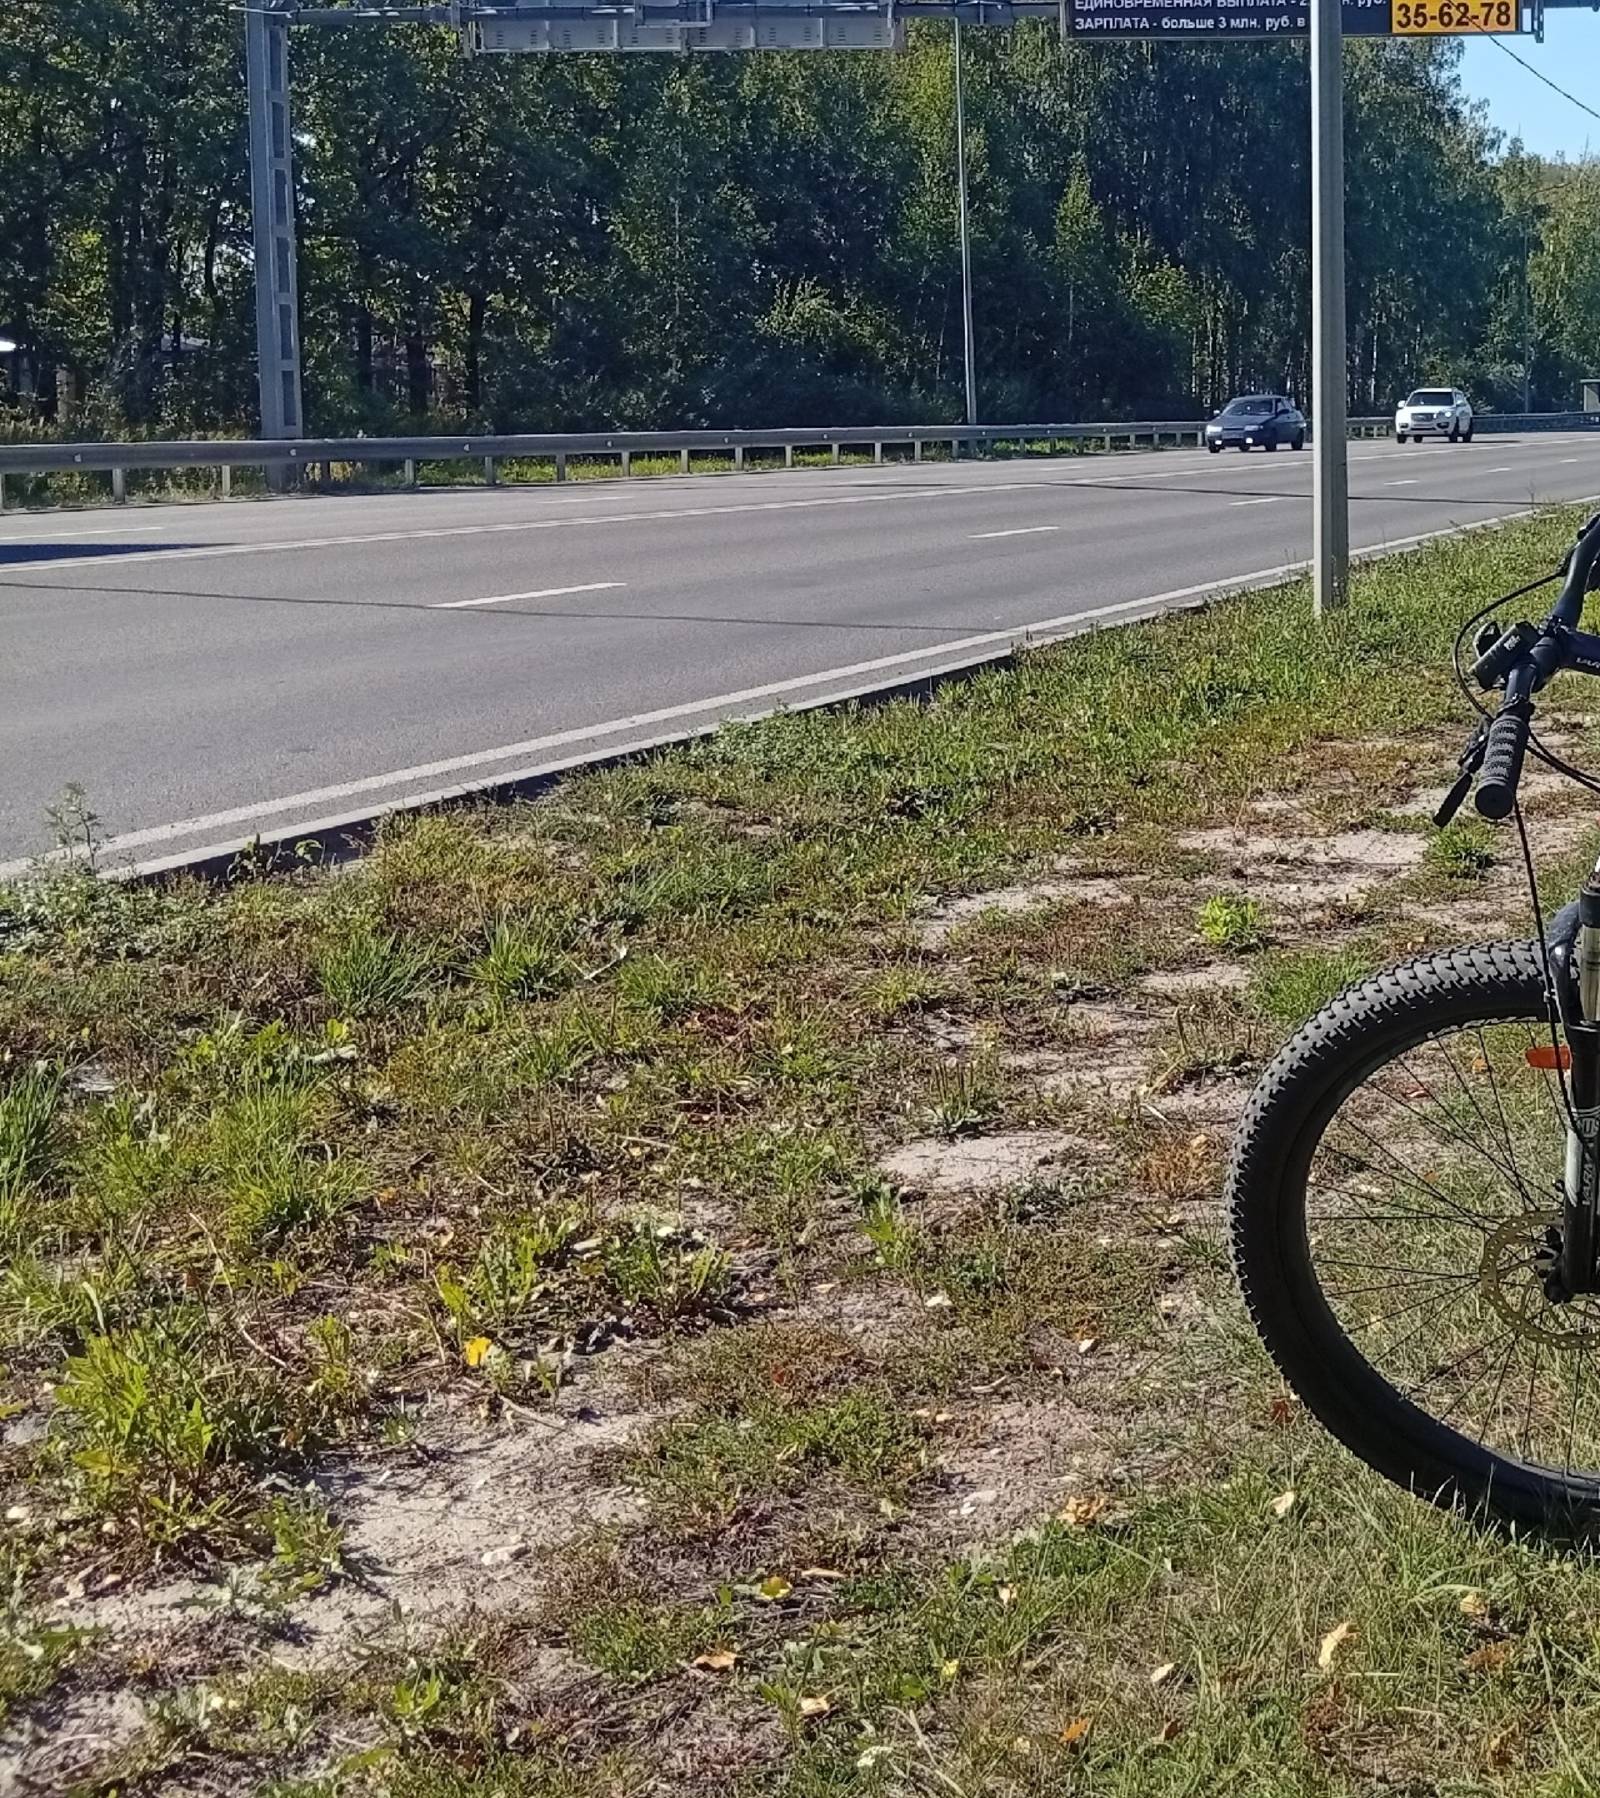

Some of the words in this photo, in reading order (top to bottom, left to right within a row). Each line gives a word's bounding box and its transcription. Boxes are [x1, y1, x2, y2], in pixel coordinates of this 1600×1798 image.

[1075, 0, 1213, 11] ЕДИНОВРЕМЕННАЯ
[1075, 17, 1150, 29] ЗАРПЛАТА
[1161, 16, 1215, 29] больше
[1218, 16, 1228, 28] 3
[1230, 18, 1261, 28] млн.
[1265, 15, 1294, 31] руб.
[1297, 17, 1306, 27] в
[1397, 2, 1511, 28] 35-62-78
